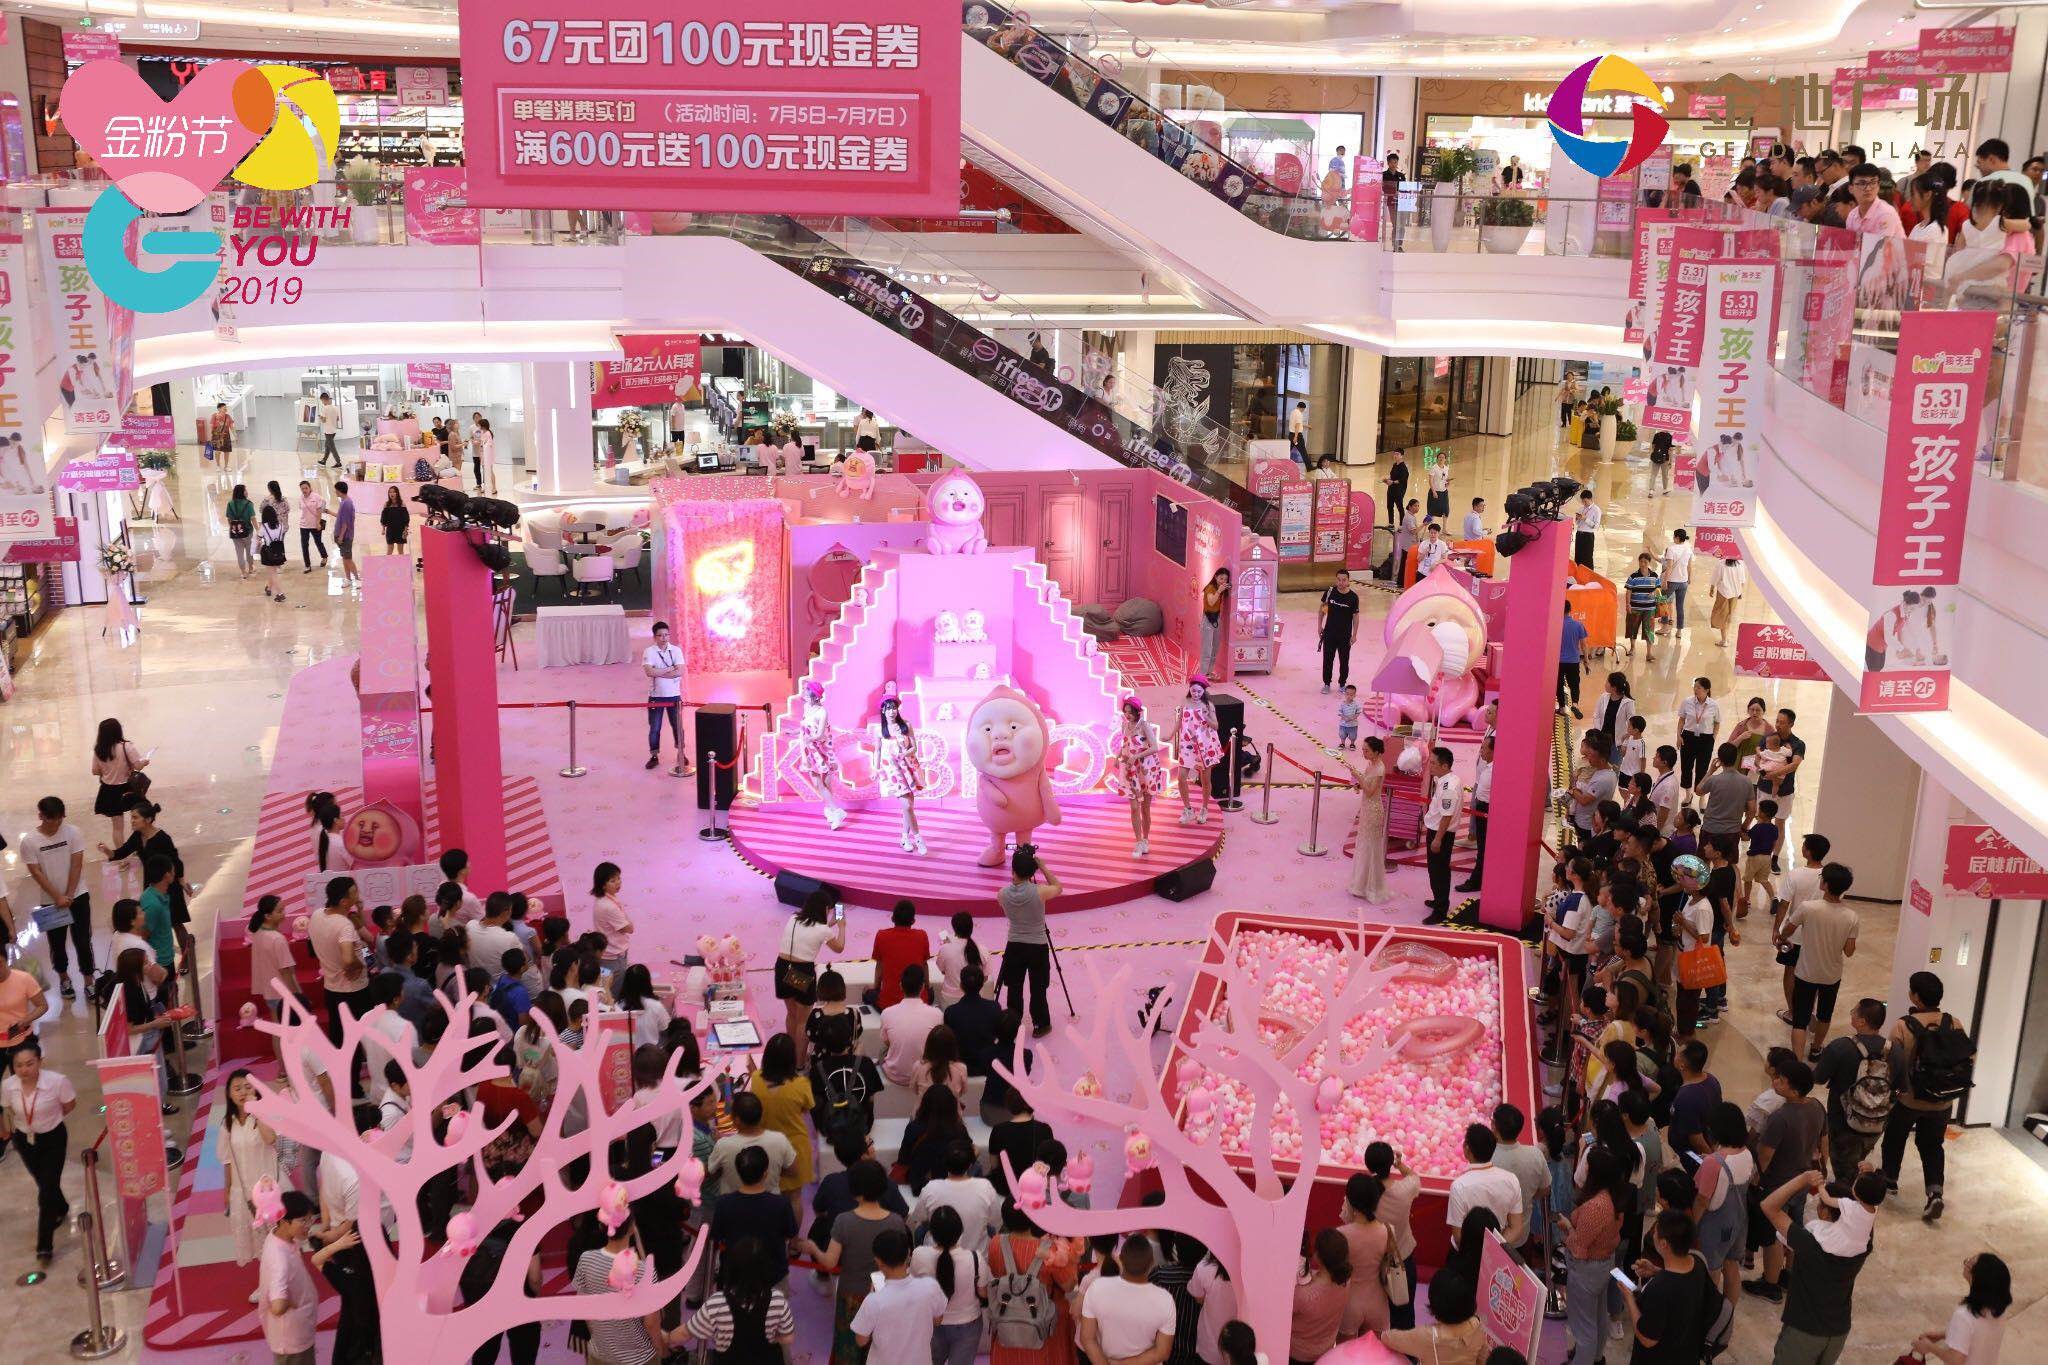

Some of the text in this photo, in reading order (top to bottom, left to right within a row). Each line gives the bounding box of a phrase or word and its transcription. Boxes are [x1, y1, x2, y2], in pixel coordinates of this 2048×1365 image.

[502, 19, 920, 69] 67元团100元现金券
[513, 99, 636, 123] 单笔消费实付
[514, 130, 908, 173] 满600元送100元现金券
[1724, 294, 1755, 309] 5.31
[1665, 288, 1703, 363] 孩子王
[1715, 327, 1755, 428] 孩子王
[1920, 389, 1961, 409] 5.31
[1919, 409, 1959, 420] 炫彩开业
[1898, 434, 1961, 578] 孩子王
[1699, 532, 1736, 543] 100积分
[1752, 645, 1814, 662] 金粉爆品
